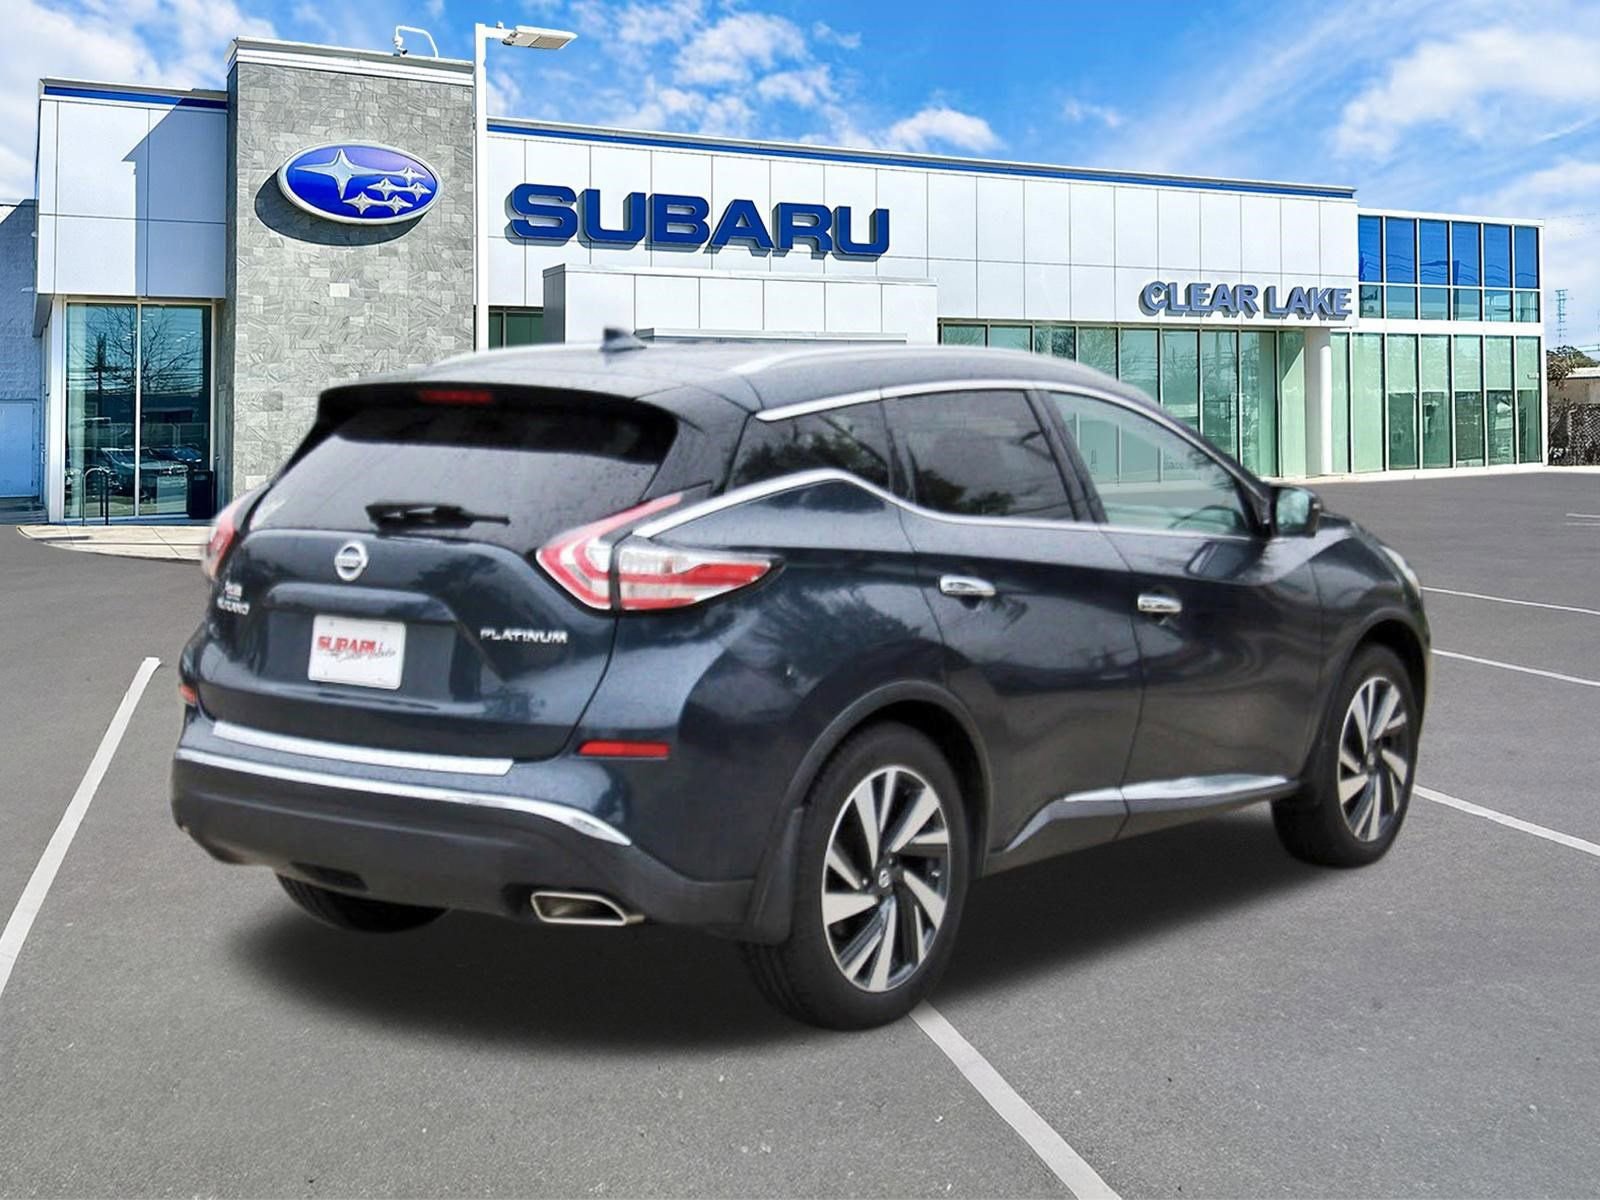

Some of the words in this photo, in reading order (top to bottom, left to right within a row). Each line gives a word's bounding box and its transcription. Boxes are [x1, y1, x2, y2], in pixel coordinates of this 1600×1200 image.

[506, 183, 890, 259] SUBARU
[1139, 281, 1260, 318] CLEAR
[1264, 285, 1352, 320] LAKE
[480, 628, 568, 643] PLATINUM
